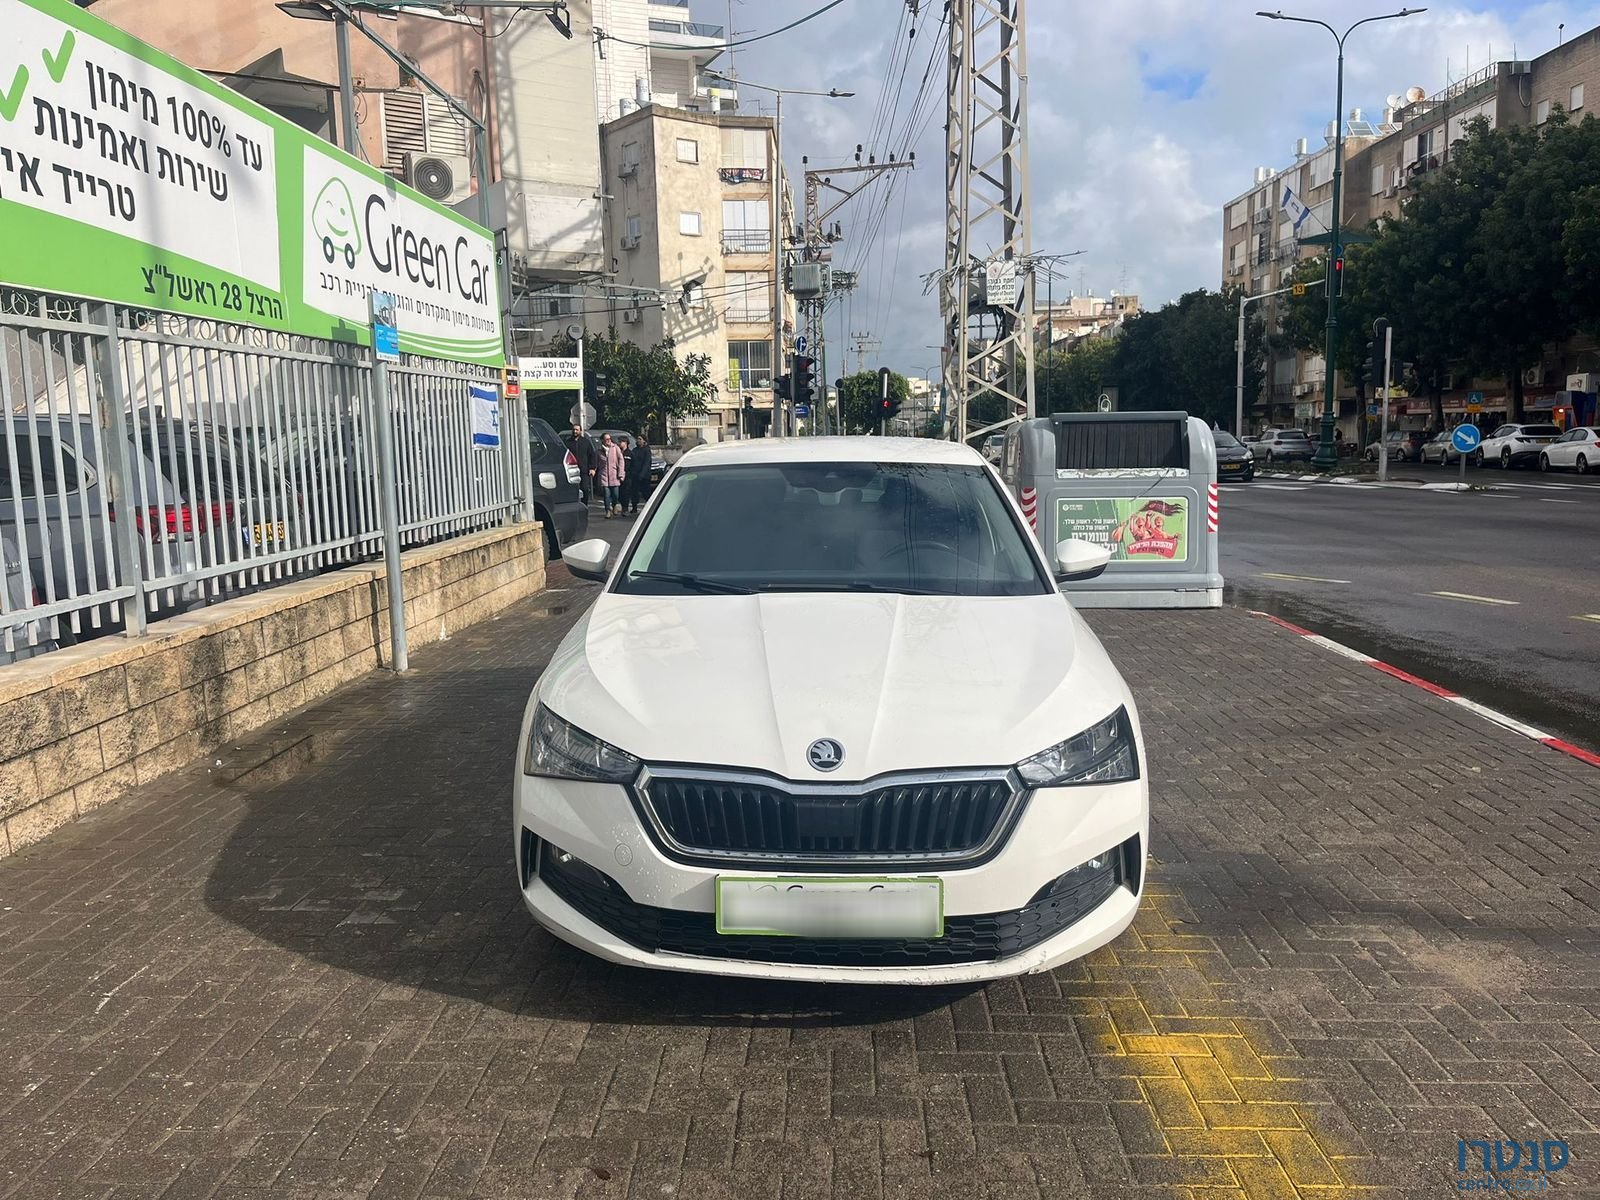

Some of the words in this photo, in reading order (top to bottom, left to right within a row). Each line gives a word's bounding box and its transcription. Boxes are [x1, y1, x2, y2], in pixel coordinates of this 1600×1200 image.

[85, 60, 159, 126] מימון
[32, 96, 150, 174] ואמינות
[167, 96, 231, 158] 100%
[236, 133, 263, 171] עד
[0, 146, 44, 198] אי
[156, 145, 228, 201] שירות
[52, 163, 136, 222] טרייד
[365, 193, 451, 293] Green
[455, 236, 489, 306] Car
[141, 263, 217, 306] ראשל"צ
[221, 281, 242, 311] 28
[319, 272, 341, 293] רכב
[1295, 285, 1303, 293] 13
[245, 285, 283, 320] הרצל
[416, 300, 450, 323] מתקדמים
[452, 310, 470, 327] מימון
[524, 370, 542, 379] קצת
[559, 360, 578, 368] שלם
[1071, 532, 1109, 542] שומרים
